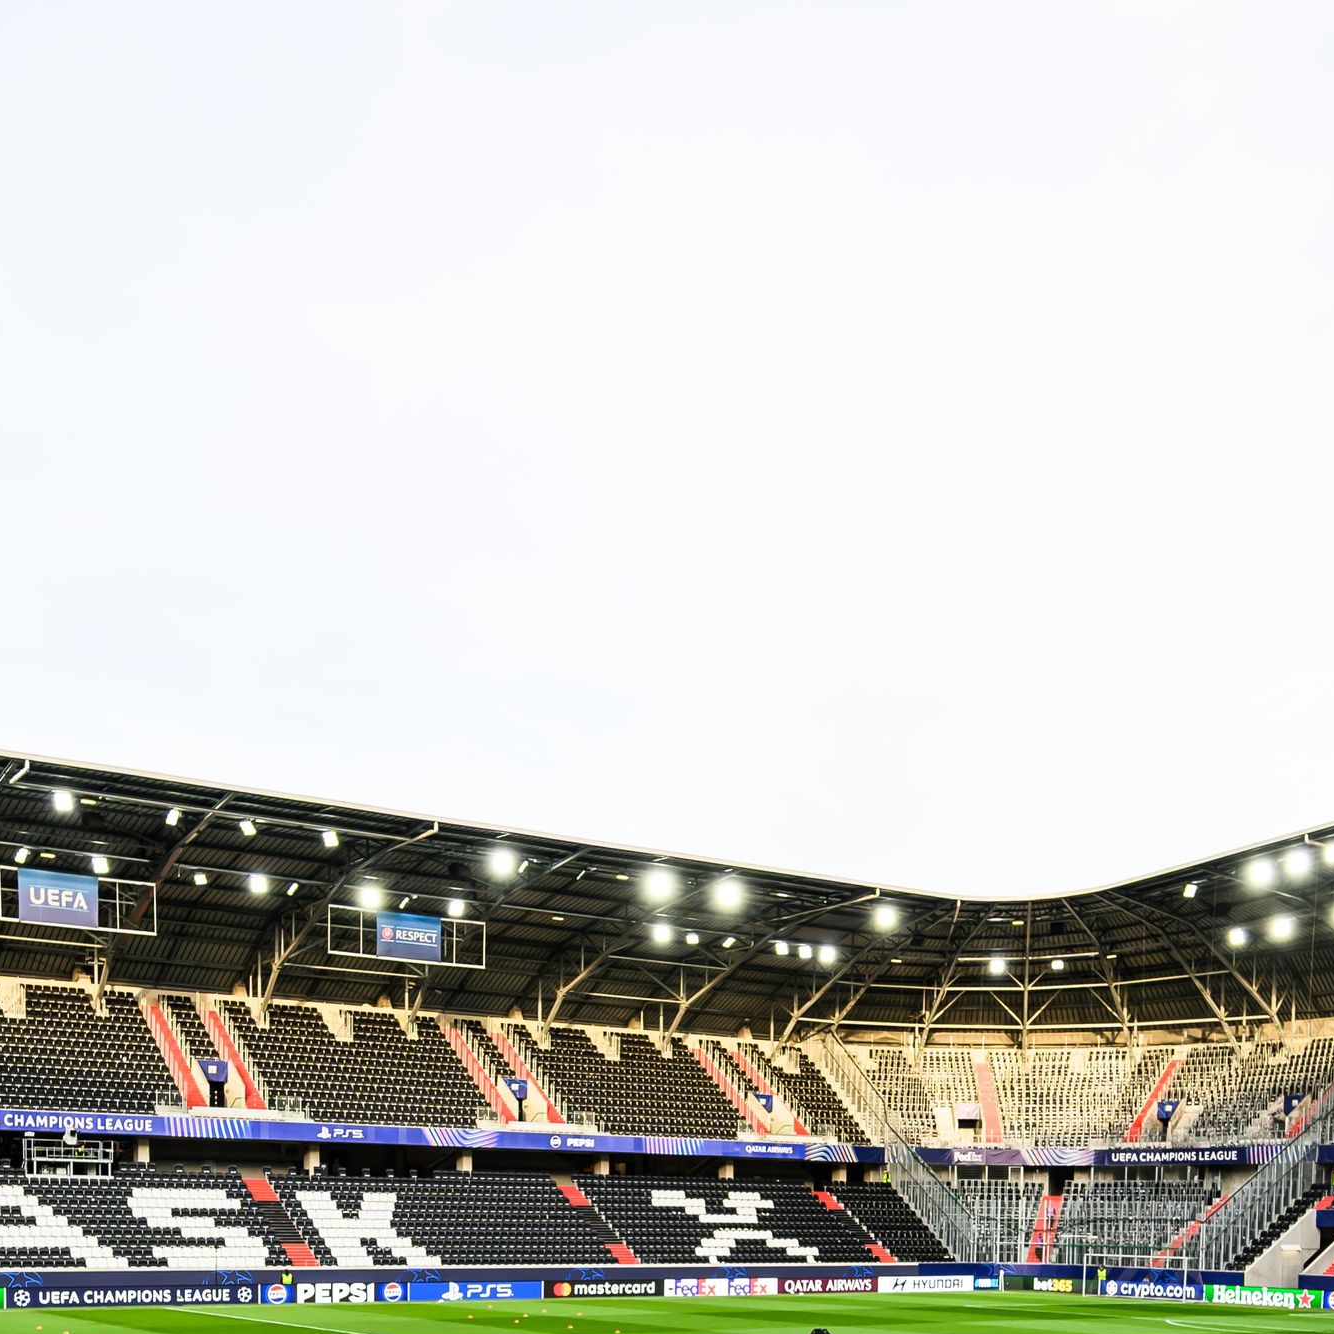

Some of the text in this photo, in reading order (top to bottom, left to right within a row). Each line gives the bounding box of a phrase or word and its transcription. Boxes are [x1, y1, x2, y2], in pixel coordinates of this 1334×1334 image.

[29, 887, 88, 910] UEFA
[395, 930, 437, 943] RESPECT
[3, 1113, 93, 1130] CHAMPIONS
[97, 1117, 153, 1132] LEAGUE
[1111, 1150, 1237, 1163] UEFA CHAMPIONS LEAGUE
[296, 1282, 375, 1304] PEPSI
[574, 1281, 655, 1296] mastercard
[728, 1277, 768, 1295] FedEx
[784, 1277, 873, 1294] QATAR AIRWAYS
[913, 1279, 963, 1290] HYUNDAI
[1033, 1277, 1073, 1293] bet365
[1120, 1281, 1196, 1300] crypto.com
[38, 1288, 230, 1305] UEFA CHAMPIONS LEAGUE
[1212, 1285, 1295, 1309] Heineken
